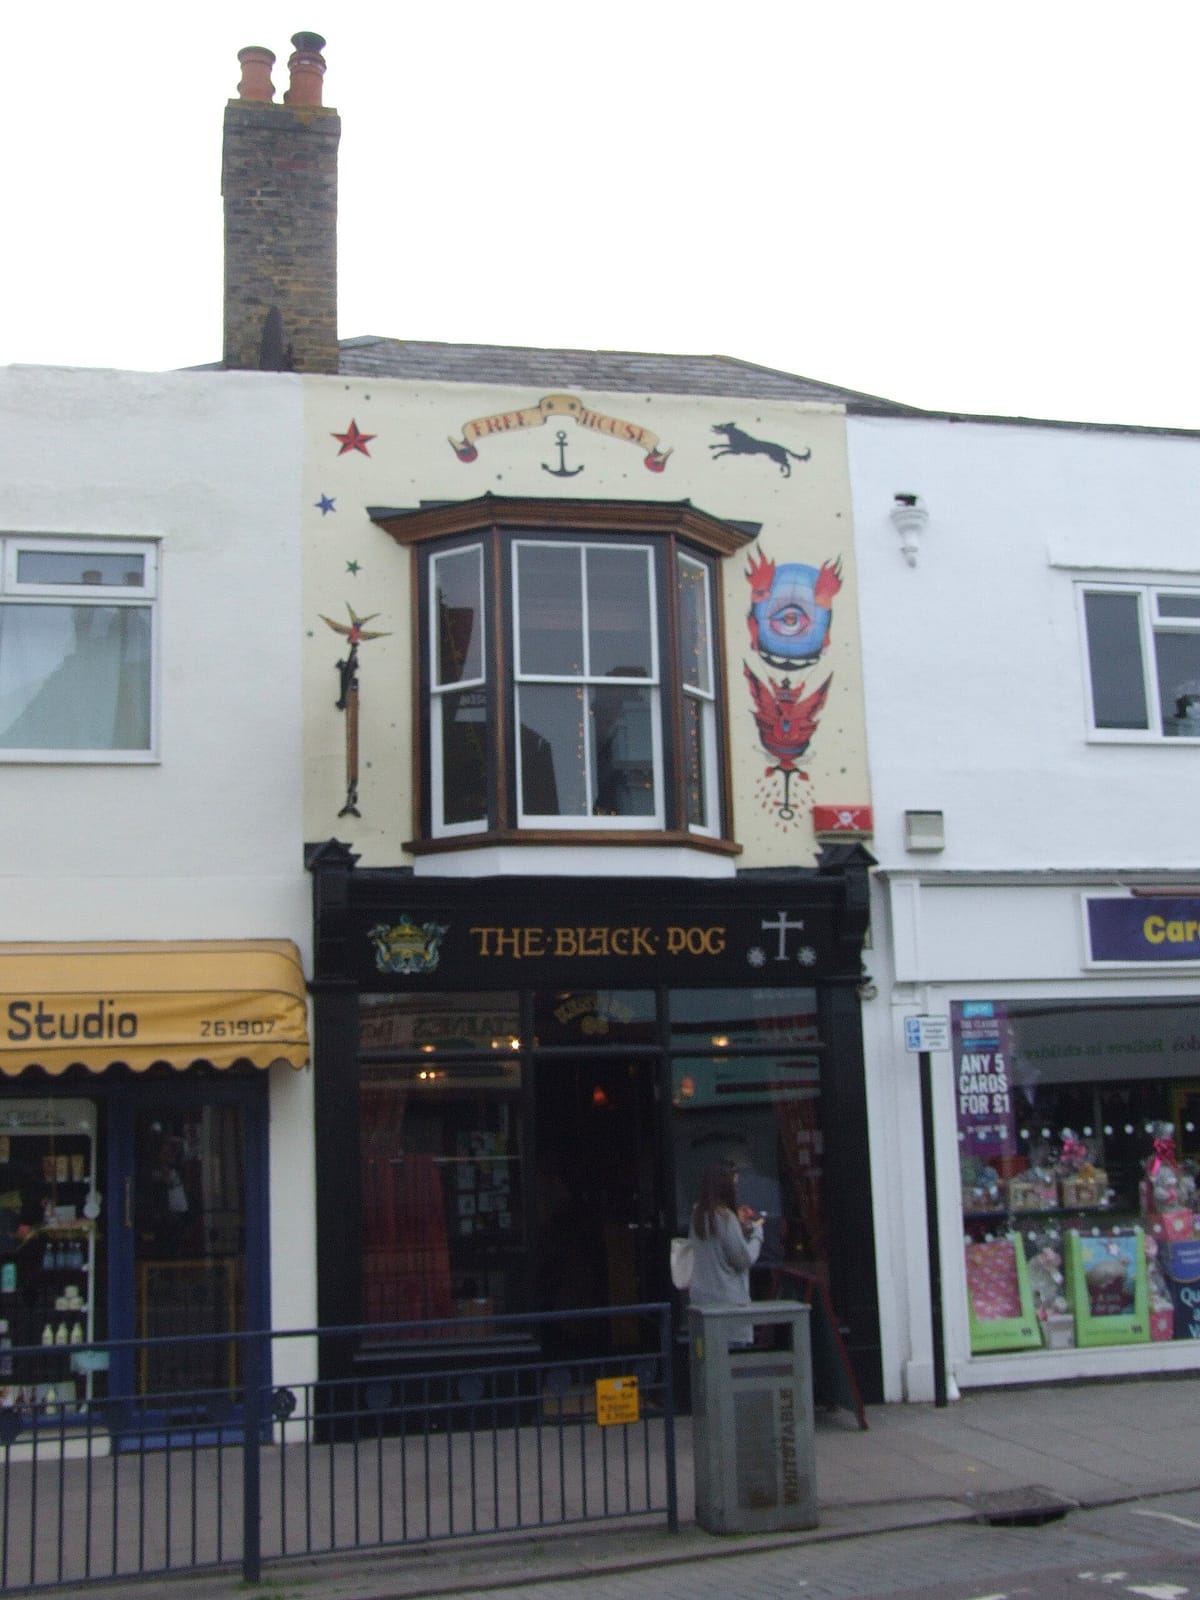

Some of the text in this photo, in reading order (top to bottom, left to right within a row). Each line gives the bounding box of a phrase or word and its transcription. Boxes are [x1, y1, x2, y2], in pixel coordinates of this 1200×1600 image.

[471, 411, 525, 436] FREE
[1143, 915, 1200, 944] Car
[469, 926, 726, 959] THE BLACK DOG
[7, 999, 138, 1041] Studio
[201, 1018, 276, 1038] 261907
[960, 1053, 1005, 1074] ANY 5
[959, 1073, 1008, 1094] CARDS
[960, 1093, 1010, 1115] FOR £1
